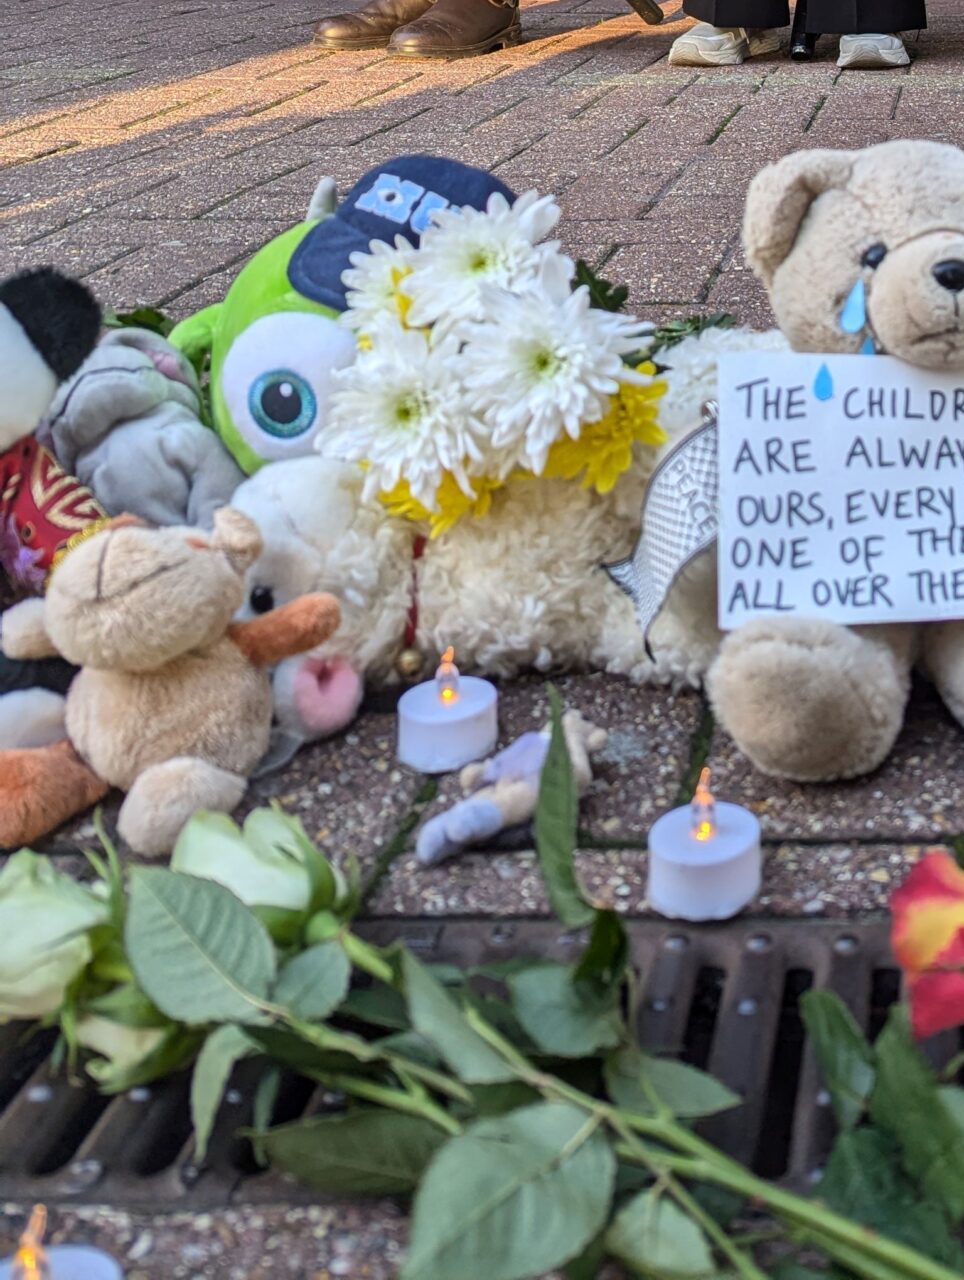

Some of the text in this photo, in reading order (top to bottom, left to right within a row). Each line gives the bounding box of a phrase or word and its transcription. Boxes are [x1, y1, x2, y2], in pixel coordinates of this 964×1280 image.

[734, 377, 807, 420] THE
[732, 436, 817, 475] ARE
[737, 490, 834, 530] OURS,
[845, 485, 957, 526] EVERY
[730, 535, 813, 569] ONE
[839, 534, 886, 572] OF
[727, 578, 797, 613] ALL
[811, 573, 894, 608] OVER
